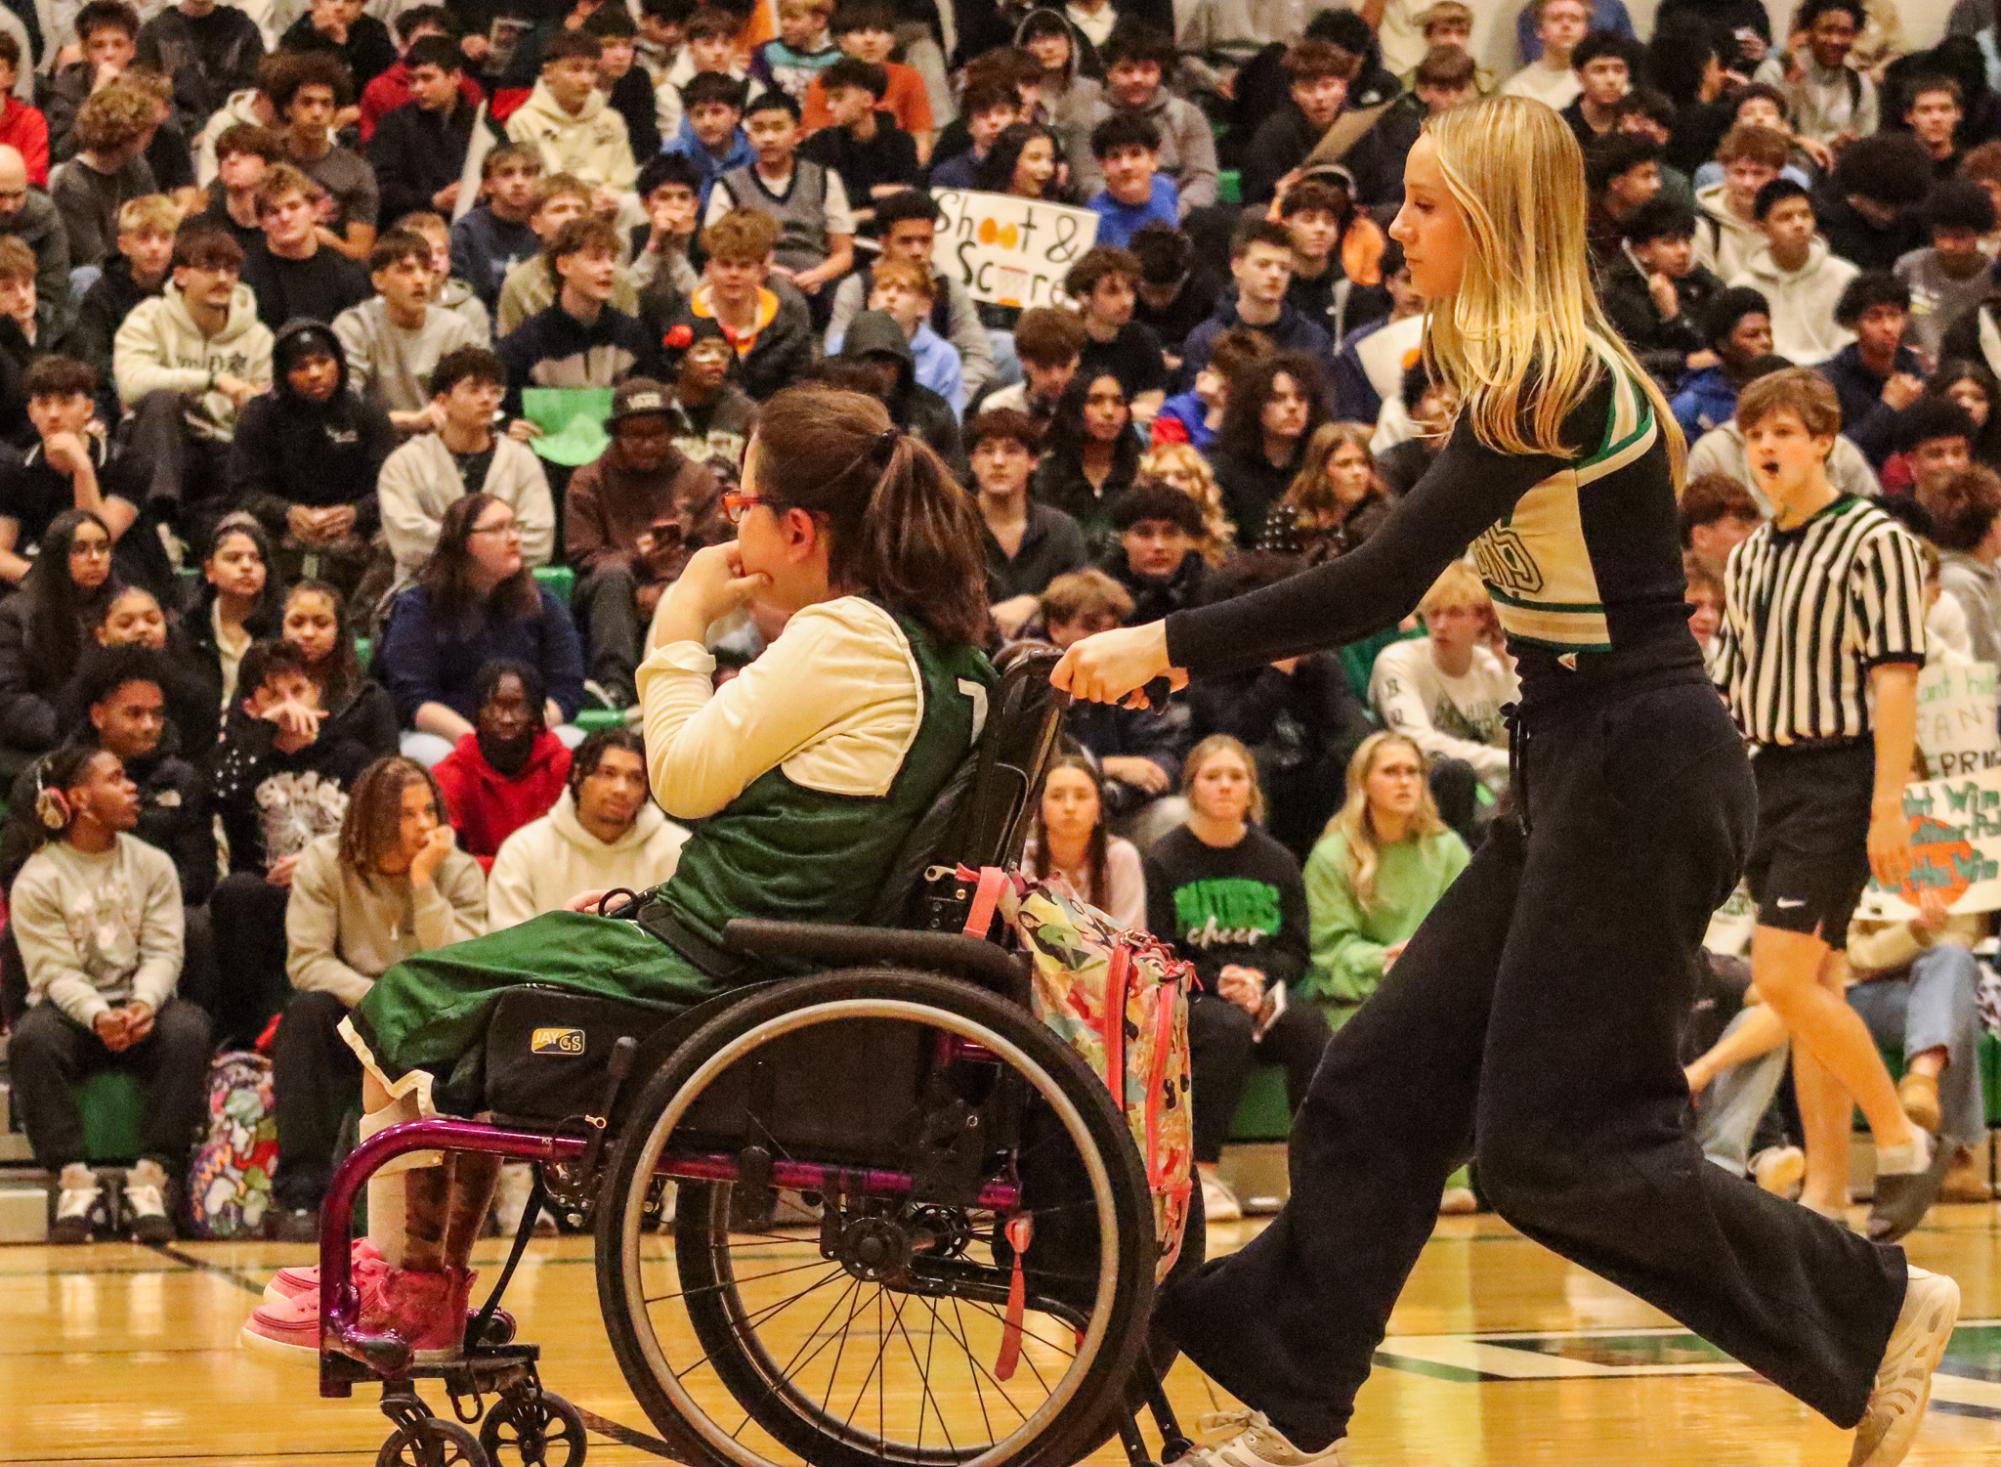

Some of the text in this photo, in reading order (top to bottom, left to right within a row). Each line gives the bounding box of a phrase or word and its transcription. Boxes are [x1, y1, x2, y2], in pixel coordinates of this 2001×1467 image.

[1045, 214, 1080, 263] &
[534, 1031, 582, 1051] JAY GS
